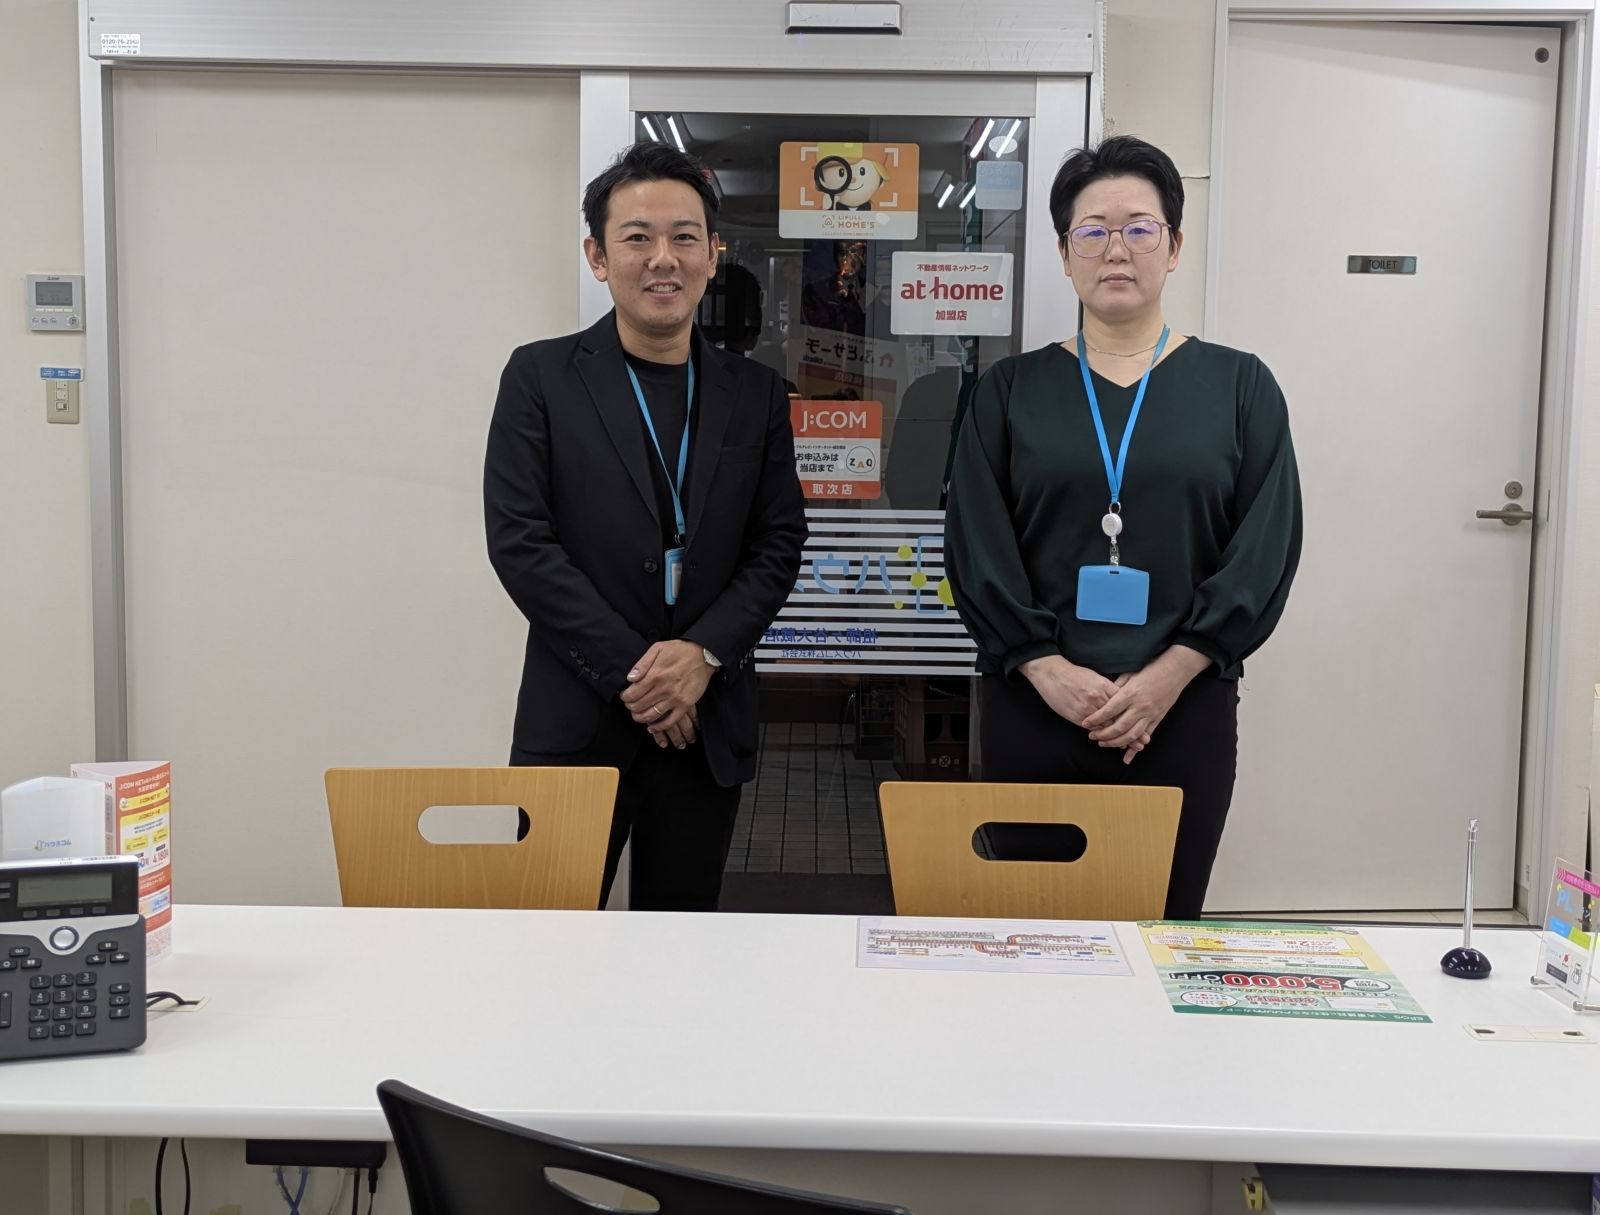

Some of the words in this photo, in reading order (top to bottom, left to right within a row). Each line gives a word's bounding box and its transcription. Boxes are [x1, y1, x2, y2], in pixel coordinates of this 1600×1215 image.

[916, 264, 990, 272] 不動産情報ネットワーク
[1368, 259, 1398, 269] TOILET
[900, 280, 926, 300] at
[929, 276, 1004, 300] home
[936, 310, 968, 321] 加盟店
[800, 410, 866, 432] J:COM
[795, 452, 839, 462] お申込みは
[800, 464, 834, 473] 当店まで
[812, 484, 852, 494] 取次店
[1220, 973, 1346, 991] 5,000
